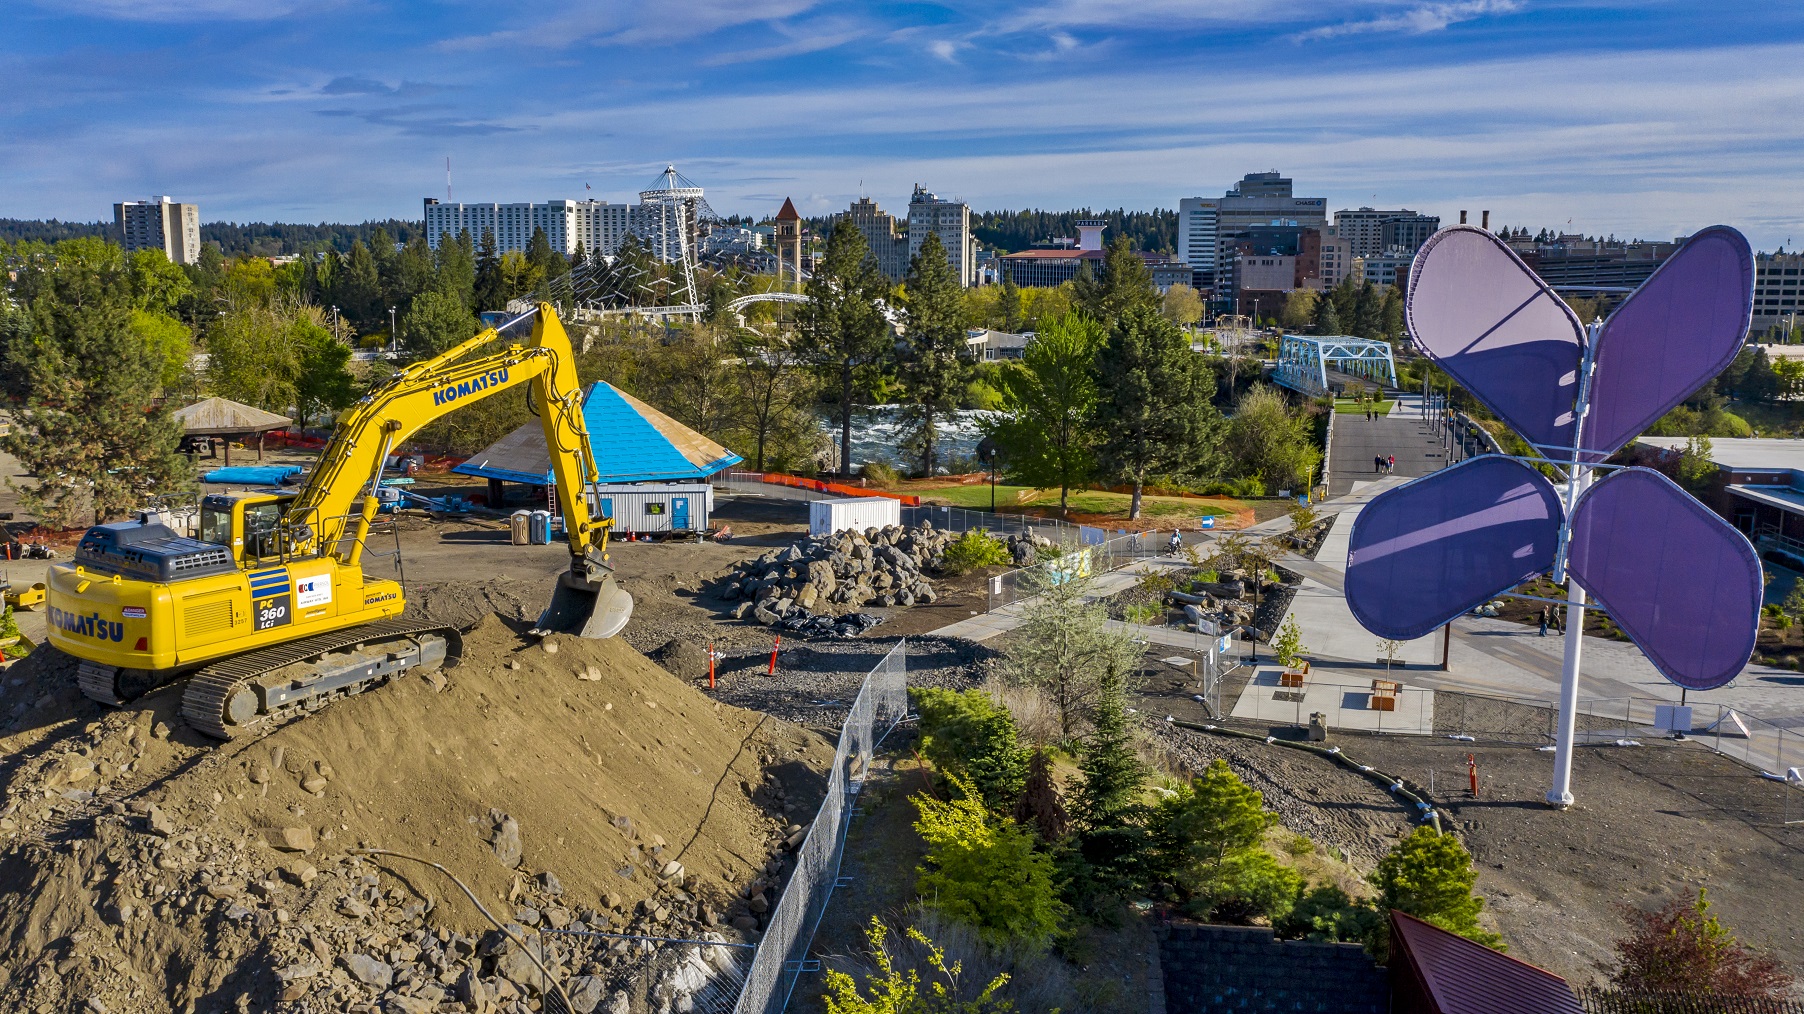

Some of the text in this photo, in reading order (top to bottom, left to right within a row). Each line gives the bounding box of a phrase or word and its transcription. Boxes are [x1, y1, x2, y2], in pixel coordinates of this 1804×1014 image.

[433, 368, 509, 406] KOMATSU
[260, 599, 274, 610] PC
[365, 592, 397, 605] KOMATSU
[260, 606, 286, 621] 360
[48, 605, 124, 643] KOMATSU
